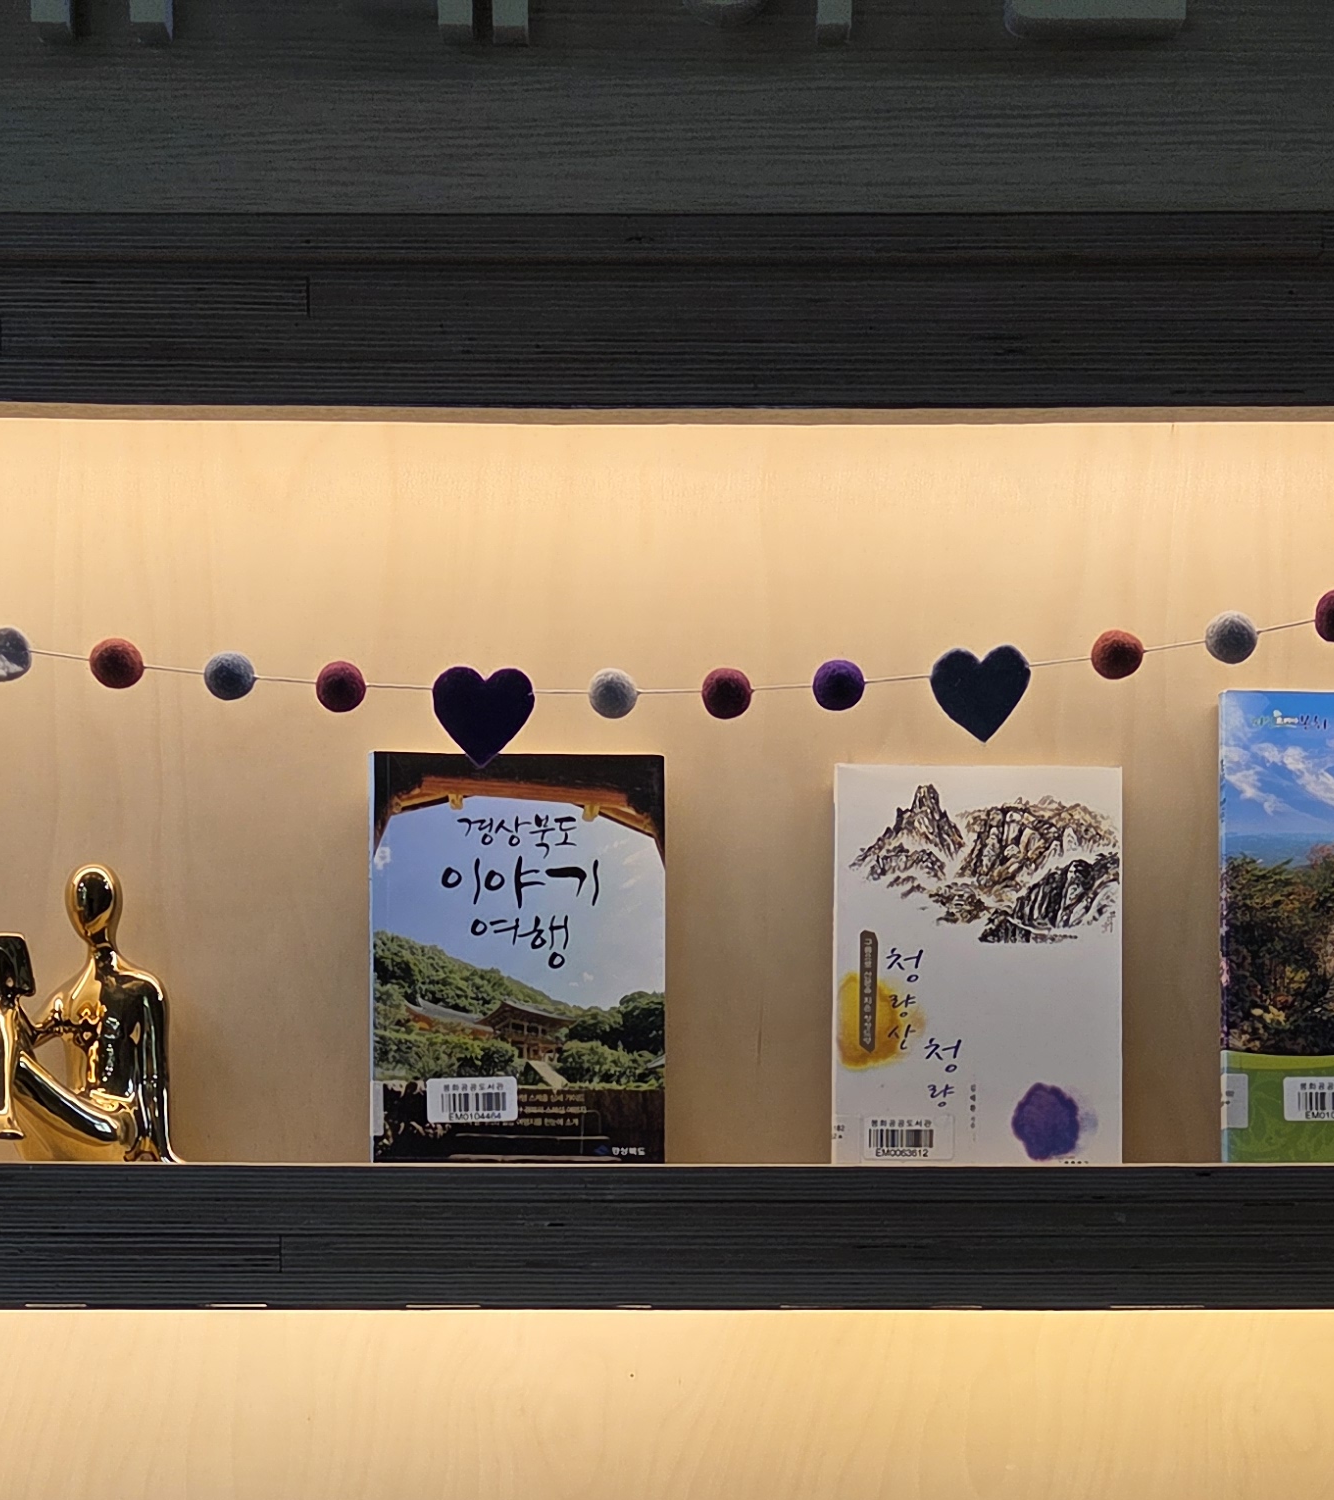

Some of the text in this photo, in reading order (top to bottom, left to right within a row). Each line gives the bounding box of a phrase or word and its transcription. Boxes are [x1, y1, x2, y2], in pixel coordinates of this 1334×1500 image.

[457, 813, 578, 859] 경상북도
[441, 856, 599, 908] 이야기
[470, 915, 571, 970] 여행
